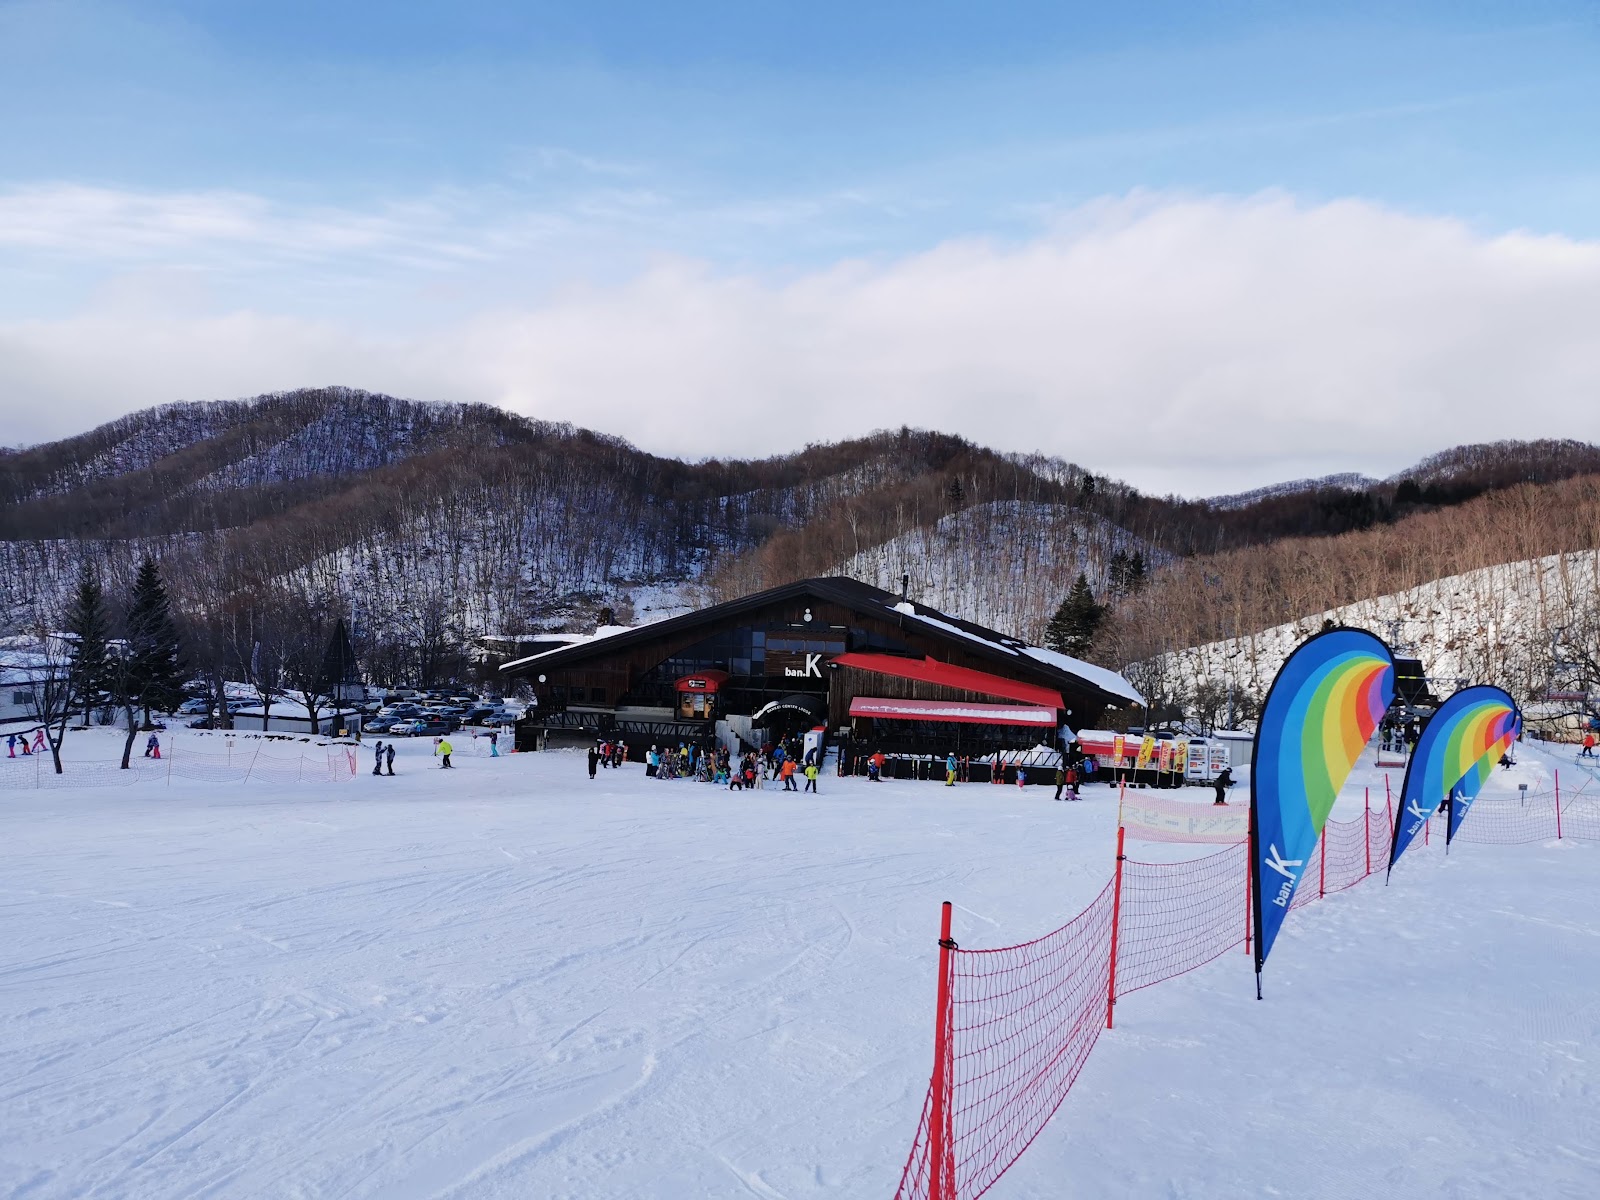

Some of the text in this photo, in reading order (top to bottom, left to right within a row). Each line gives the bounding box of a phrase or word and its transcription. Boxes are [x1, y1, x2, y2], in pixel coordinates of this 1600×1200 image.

[785, 654, 822, 678] ban.K
[1407, 799, 1431, 835] ban.K
[1455, 790, 1473, 817] ban.K
[1264, 843, 1303, 907] ban.K
